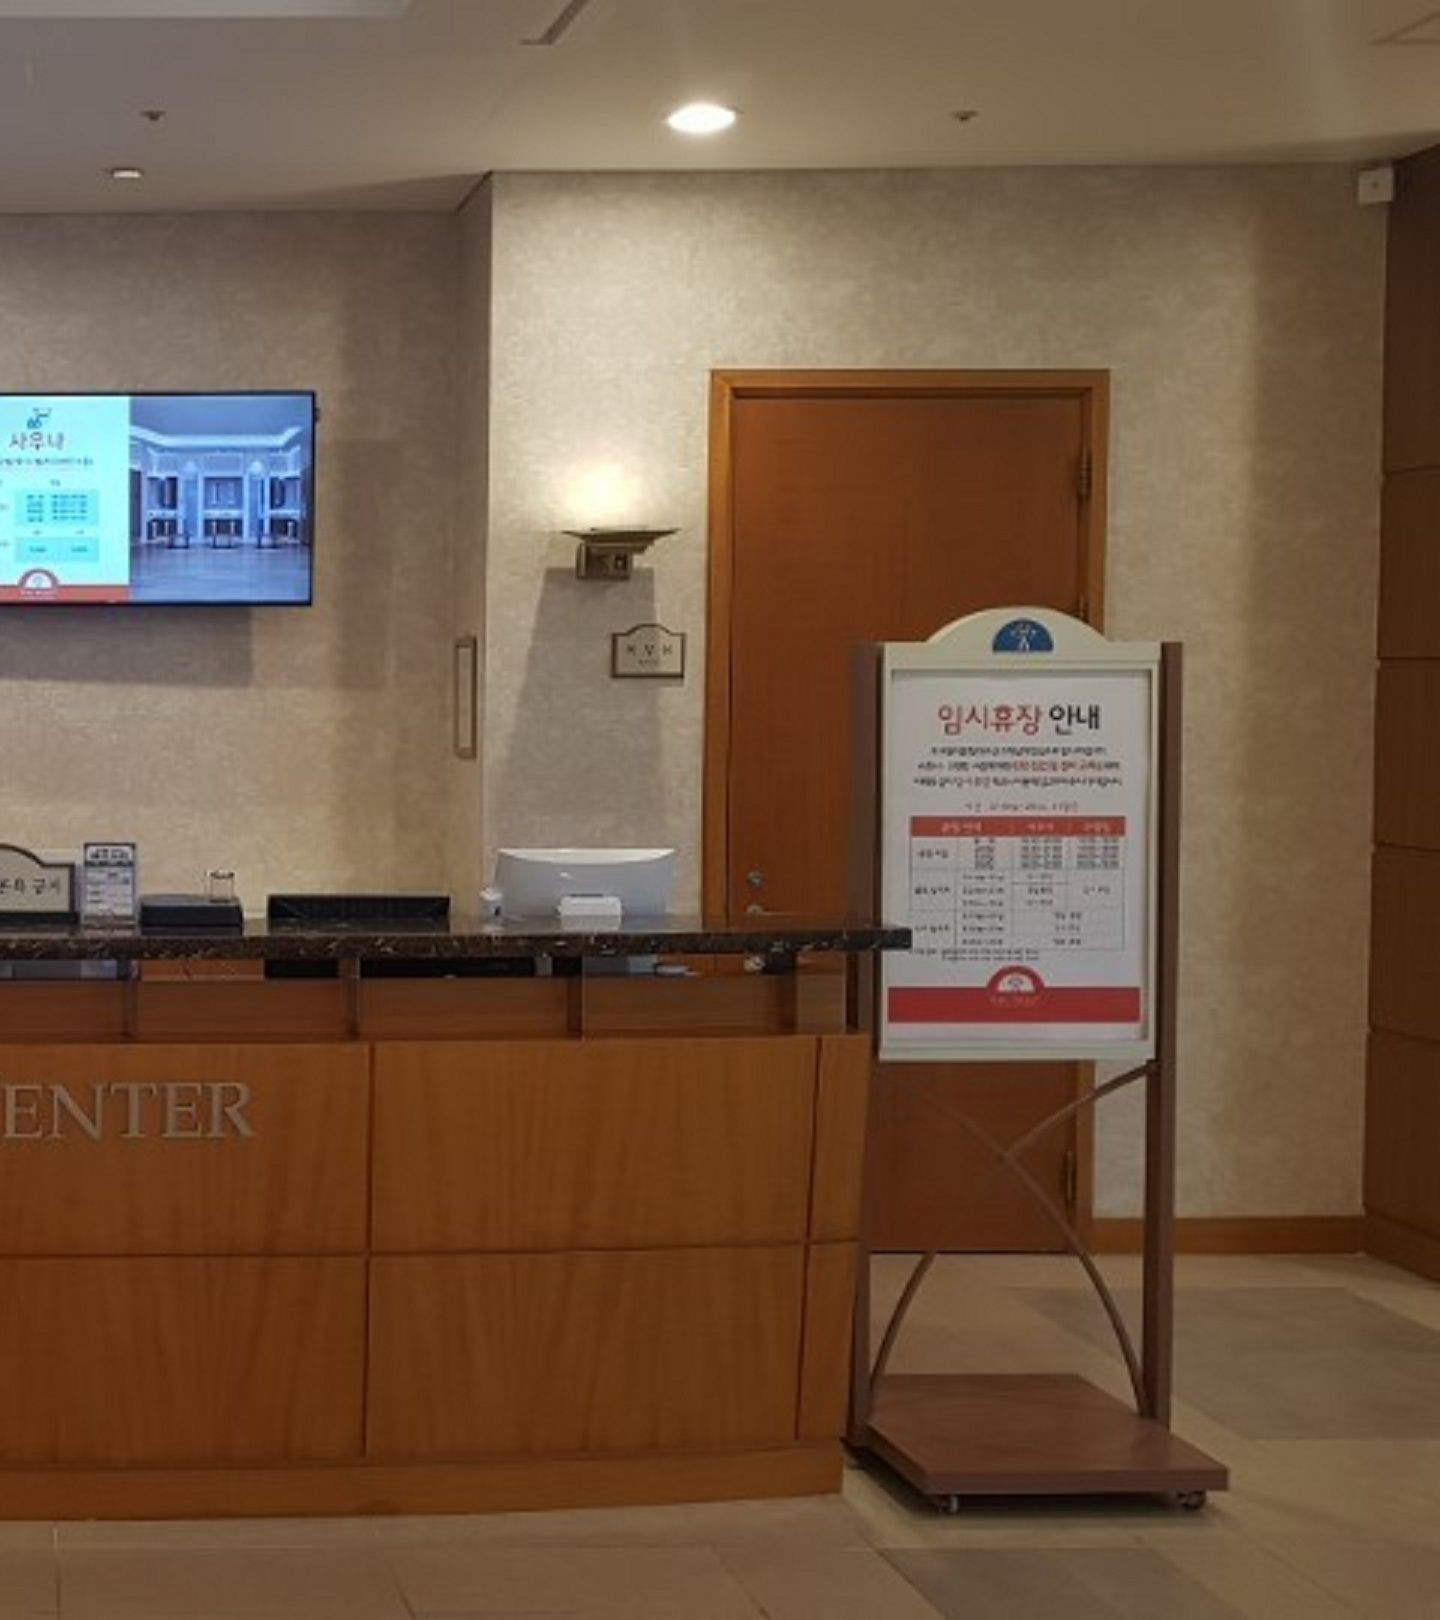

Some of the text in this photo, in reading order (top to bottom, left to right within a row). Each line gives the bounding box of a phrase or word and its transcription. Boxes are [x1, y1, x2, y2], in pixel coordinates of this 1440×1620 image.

[9, 431, 65, 452] 사우나
[937, 704, 1101, 737] 임시휴장 안내
